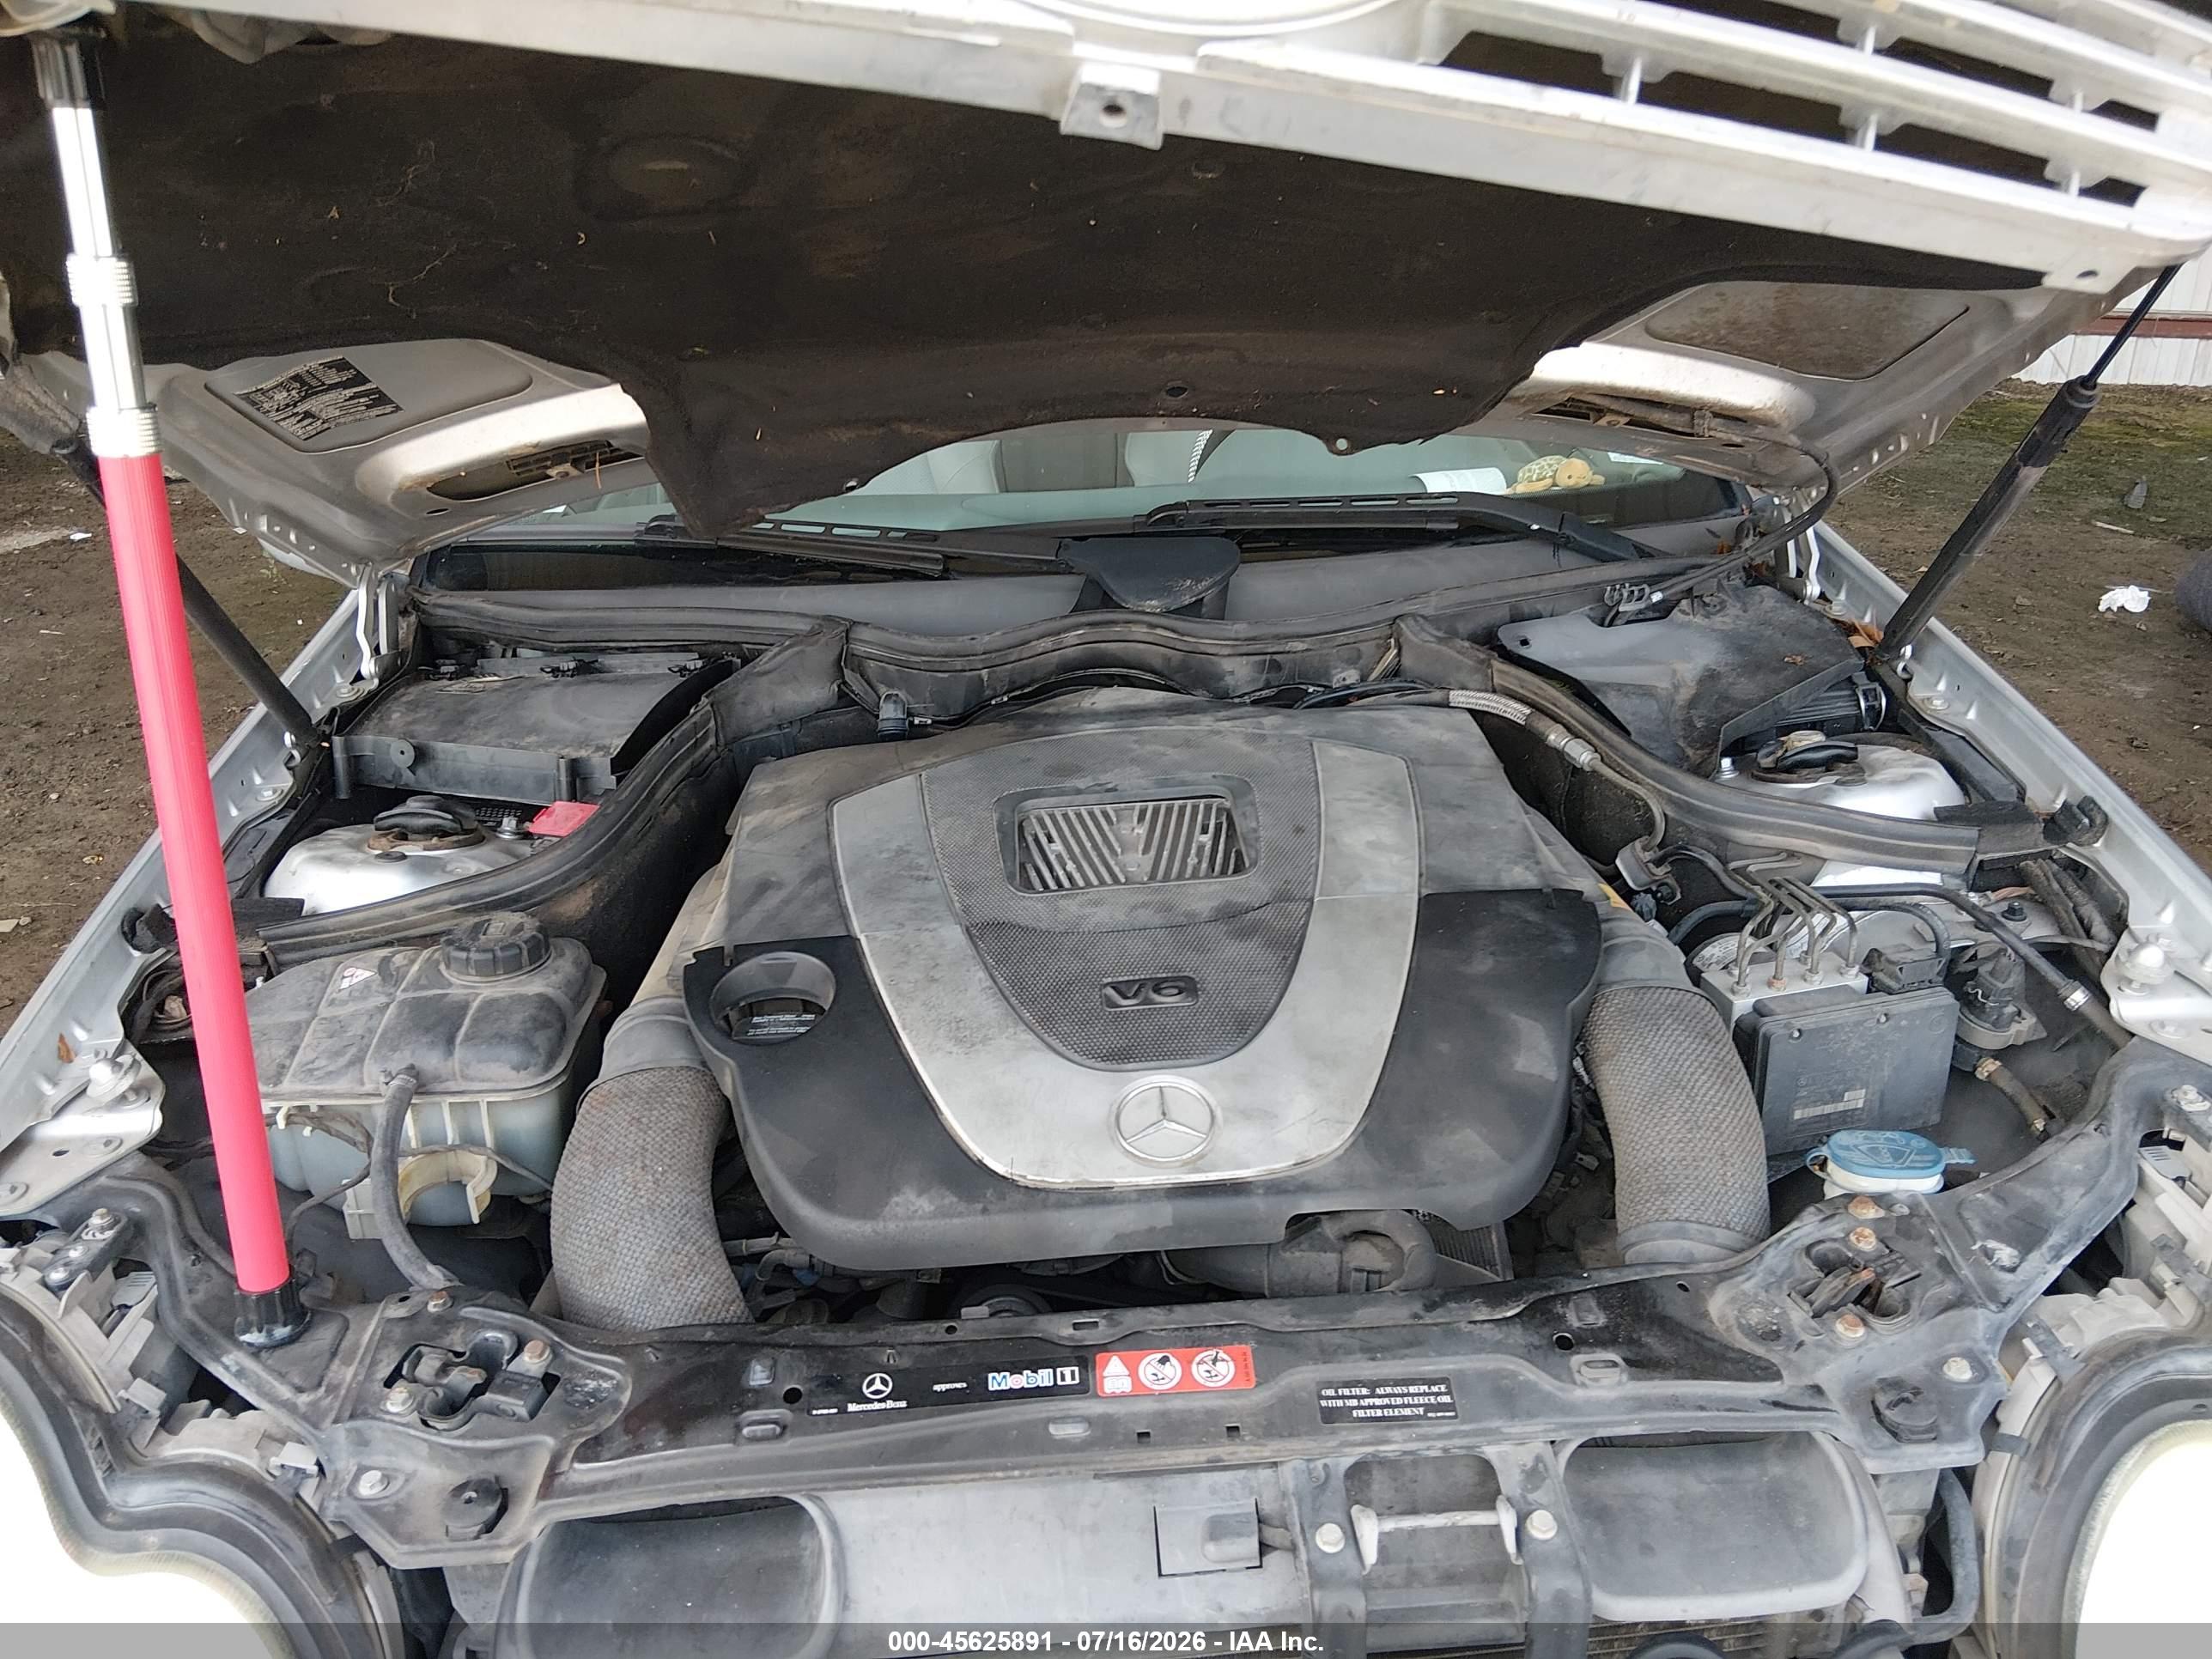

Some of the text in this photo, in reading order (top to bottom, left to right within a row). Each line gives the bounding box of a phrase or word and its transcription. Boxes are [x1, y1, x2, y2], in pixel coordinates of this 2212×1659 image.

[1103, 981, 1187, 1006] V6
[988, 1368, 1054, 1391] Mobil
[1337, 1387, 1370, 1396] FILTER:
[1374, 1385, 1408, 1395] ALWAYS
[1409, 1384, 1448, 1394] REPLACE
[1319, 1395, 1453, 1407] WITH MB APPROVED FLEECE OIL
[1352, 1408, 1382, 1418] FILTER
[1383, 1407, 1425, 1417] ELEMENT
